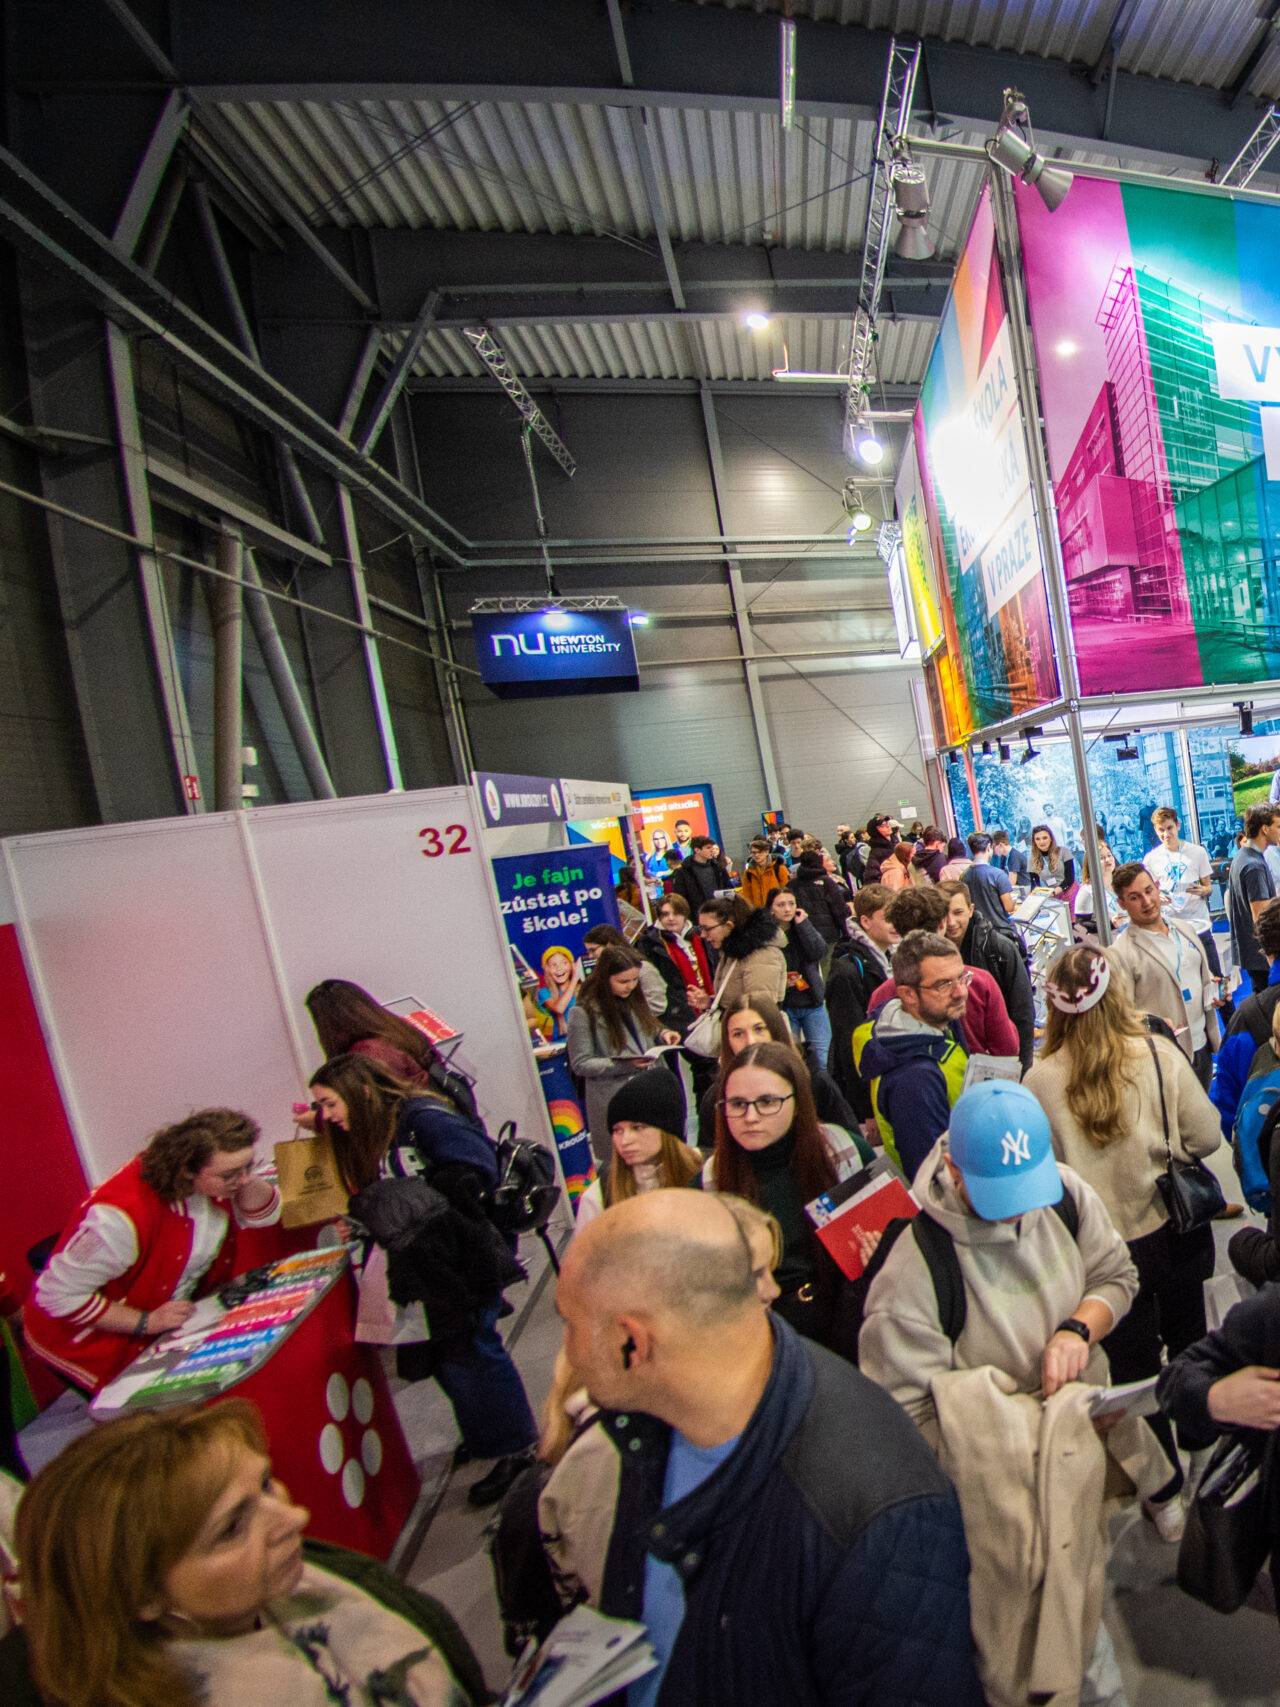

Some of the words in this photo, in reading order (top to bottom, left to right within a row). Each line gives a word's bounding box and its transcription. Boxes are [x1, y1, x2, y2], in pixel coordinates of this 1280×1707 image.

[997, 520, 1032, 586] PRAZE
[550, 634, 605, 645] NEWTON
[551, 643, 621, 654] UNIVERSITY
[419, 824, 472, 858] 32
[512, 872, 537, 890] Je
[542, 865, 584, 886] fajn
[499, 889, 570, 914] zůstat
[574, 887, 603, 904] po
[522, 908, 589, 934] škole!
